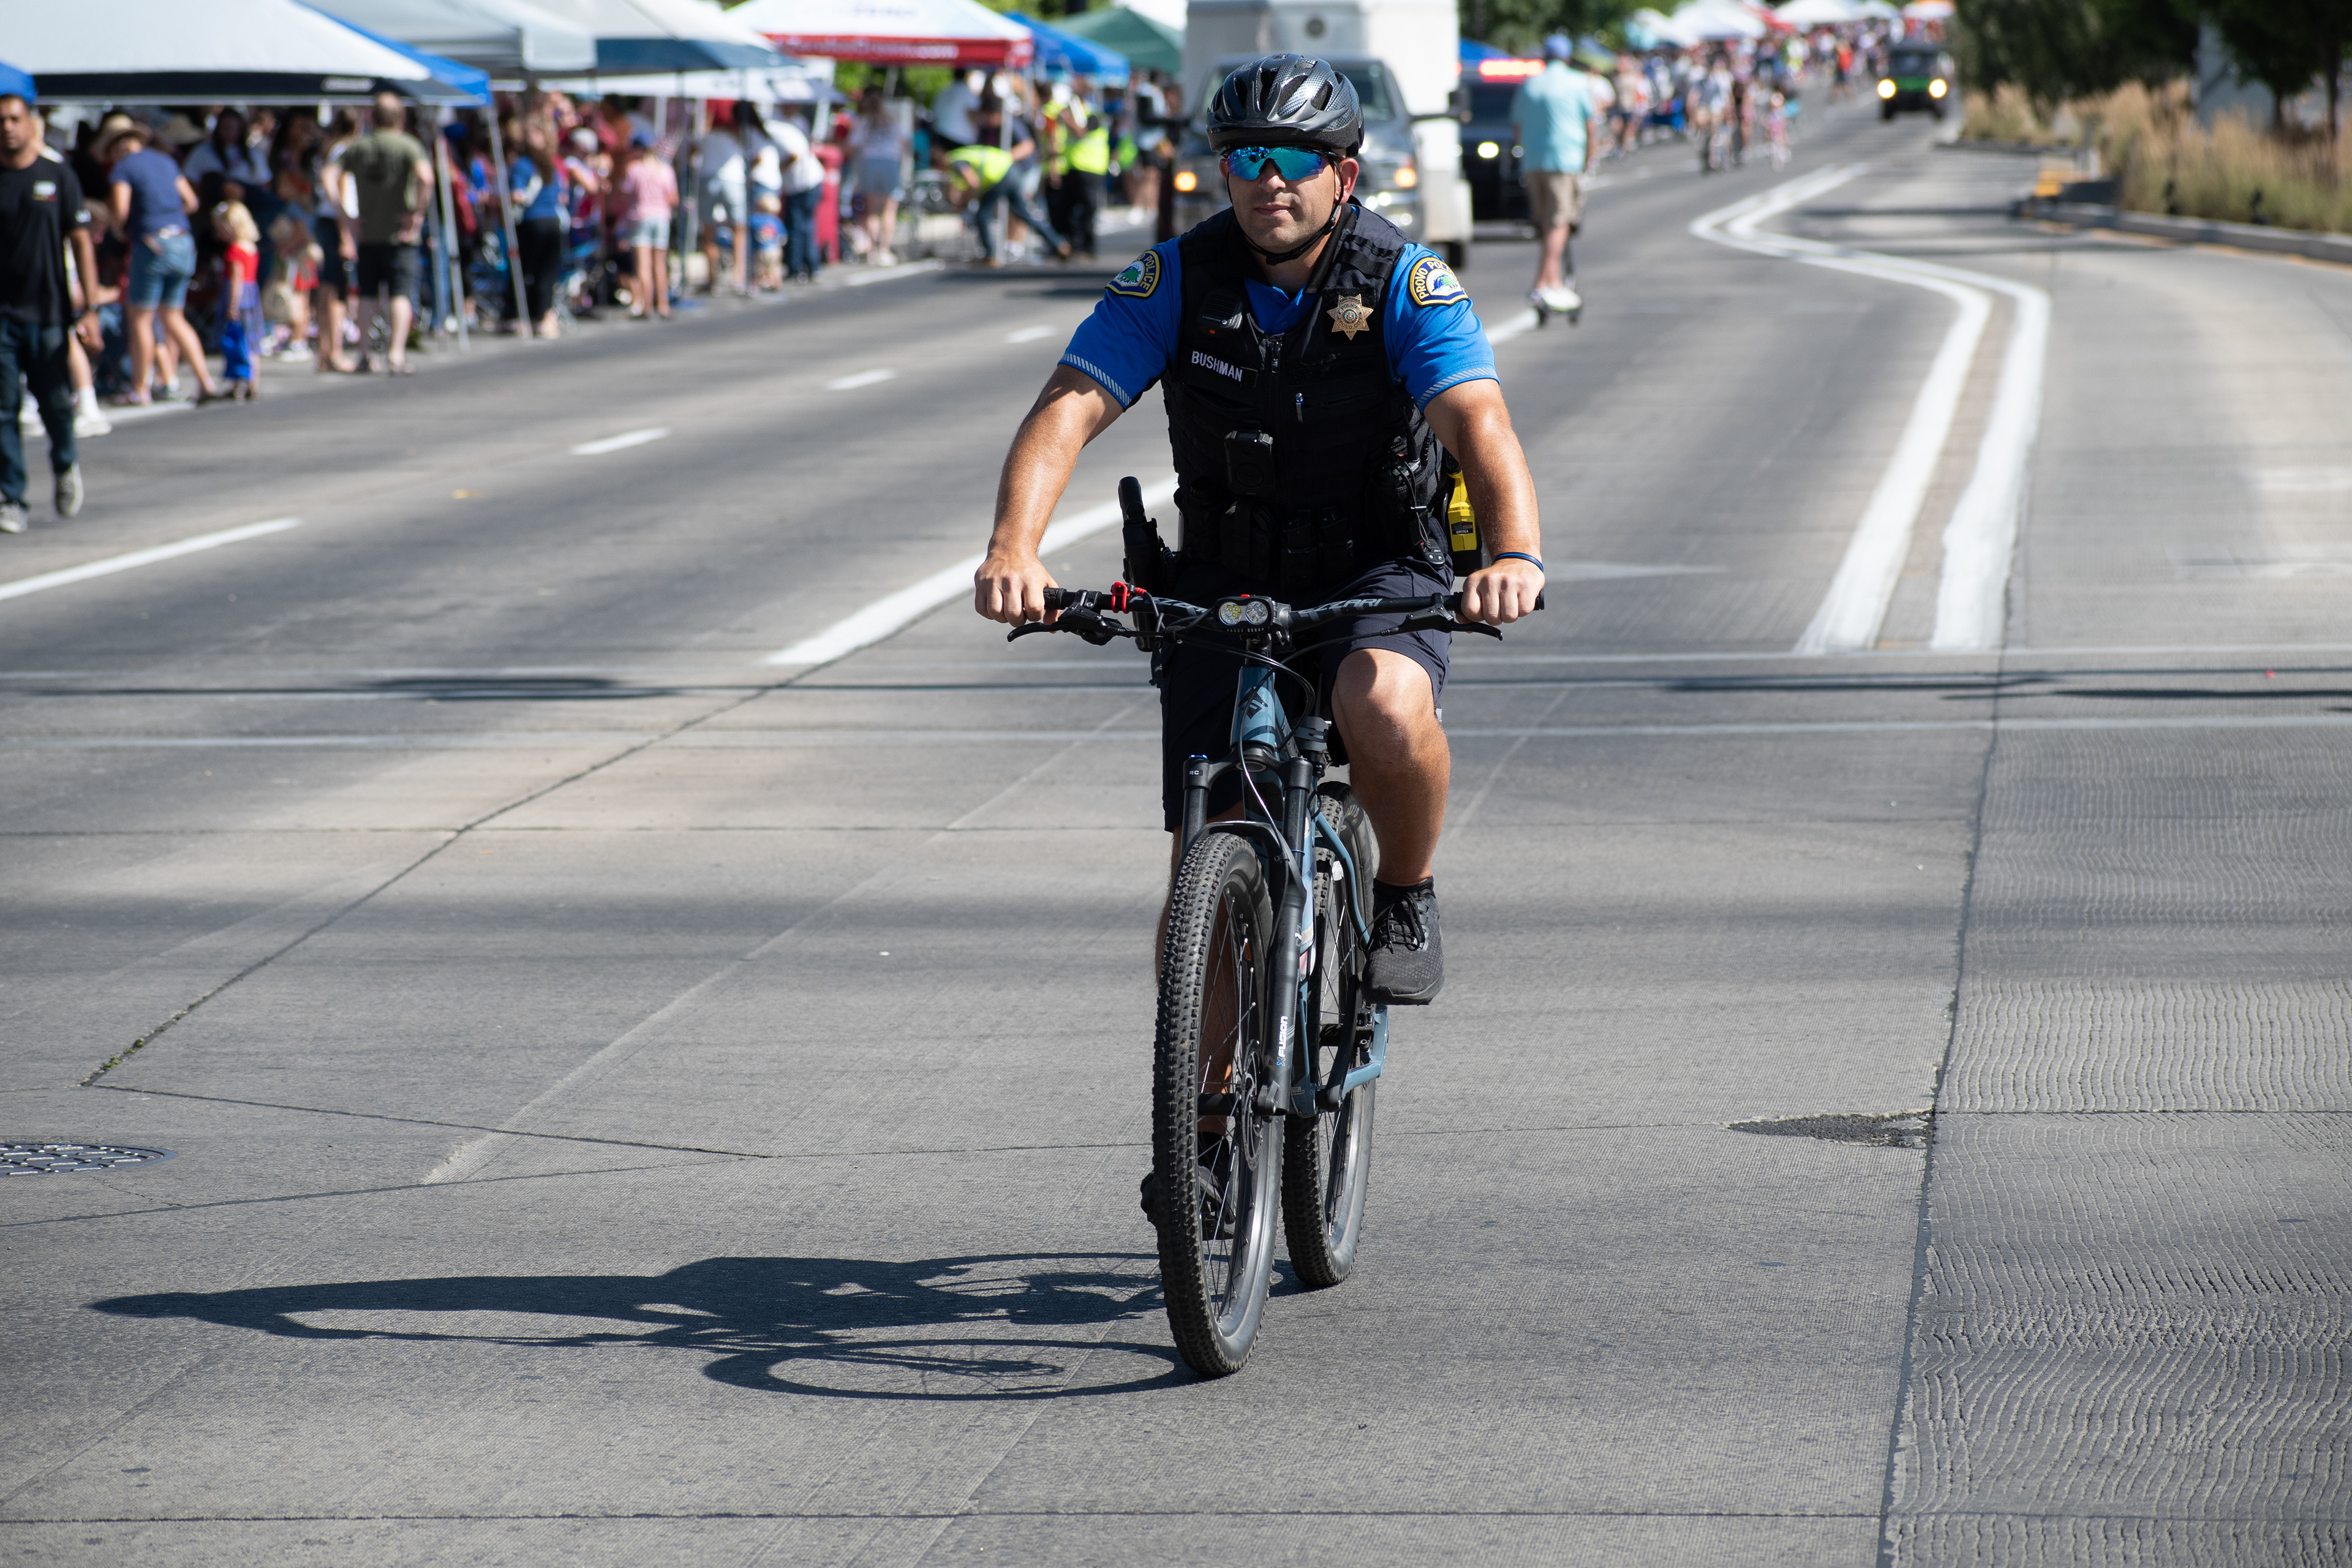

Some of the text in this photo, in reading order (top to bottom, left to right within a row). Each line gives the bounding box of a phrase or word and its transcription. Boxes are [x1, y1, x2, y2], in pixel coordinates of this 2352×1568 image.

[1140, 255, 1155, 290] POLICE
[1415, 268, 1429, 300] PROVO
[1338, 316, 1362, 329] PROVO CITY
[1191, 351, 1243, 382] BUSHMAN
